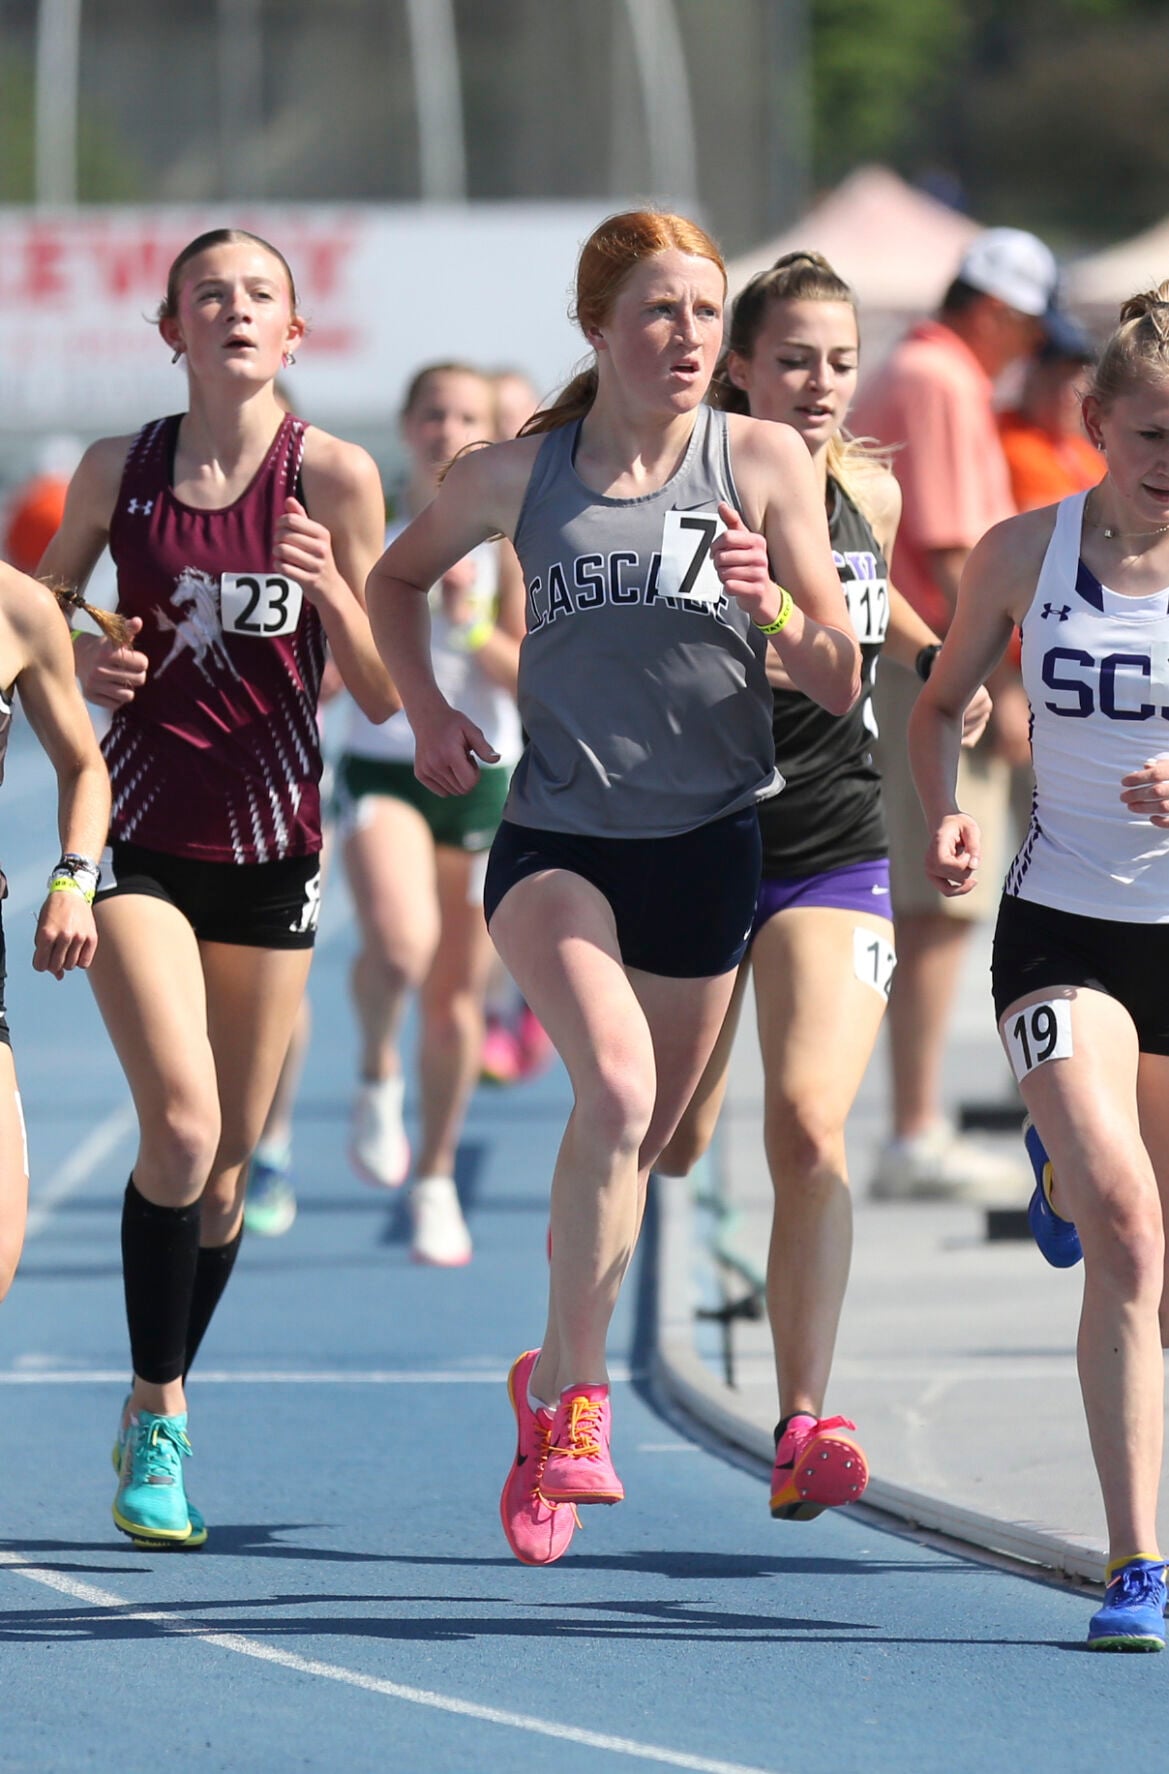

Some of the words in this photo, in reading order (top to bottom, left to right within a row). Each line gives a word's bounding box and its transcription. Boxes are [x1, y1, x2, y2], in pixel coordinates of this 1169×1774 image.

[678, 517, 717, 593] 7
[234, 577, 289, 632] 23
[528, 551, 728, 634] CASC
[860, 586, 886, 636] 12
[1042, 647, 1169, 721] SC
[1013, 1004, 1058, 1070] 19
